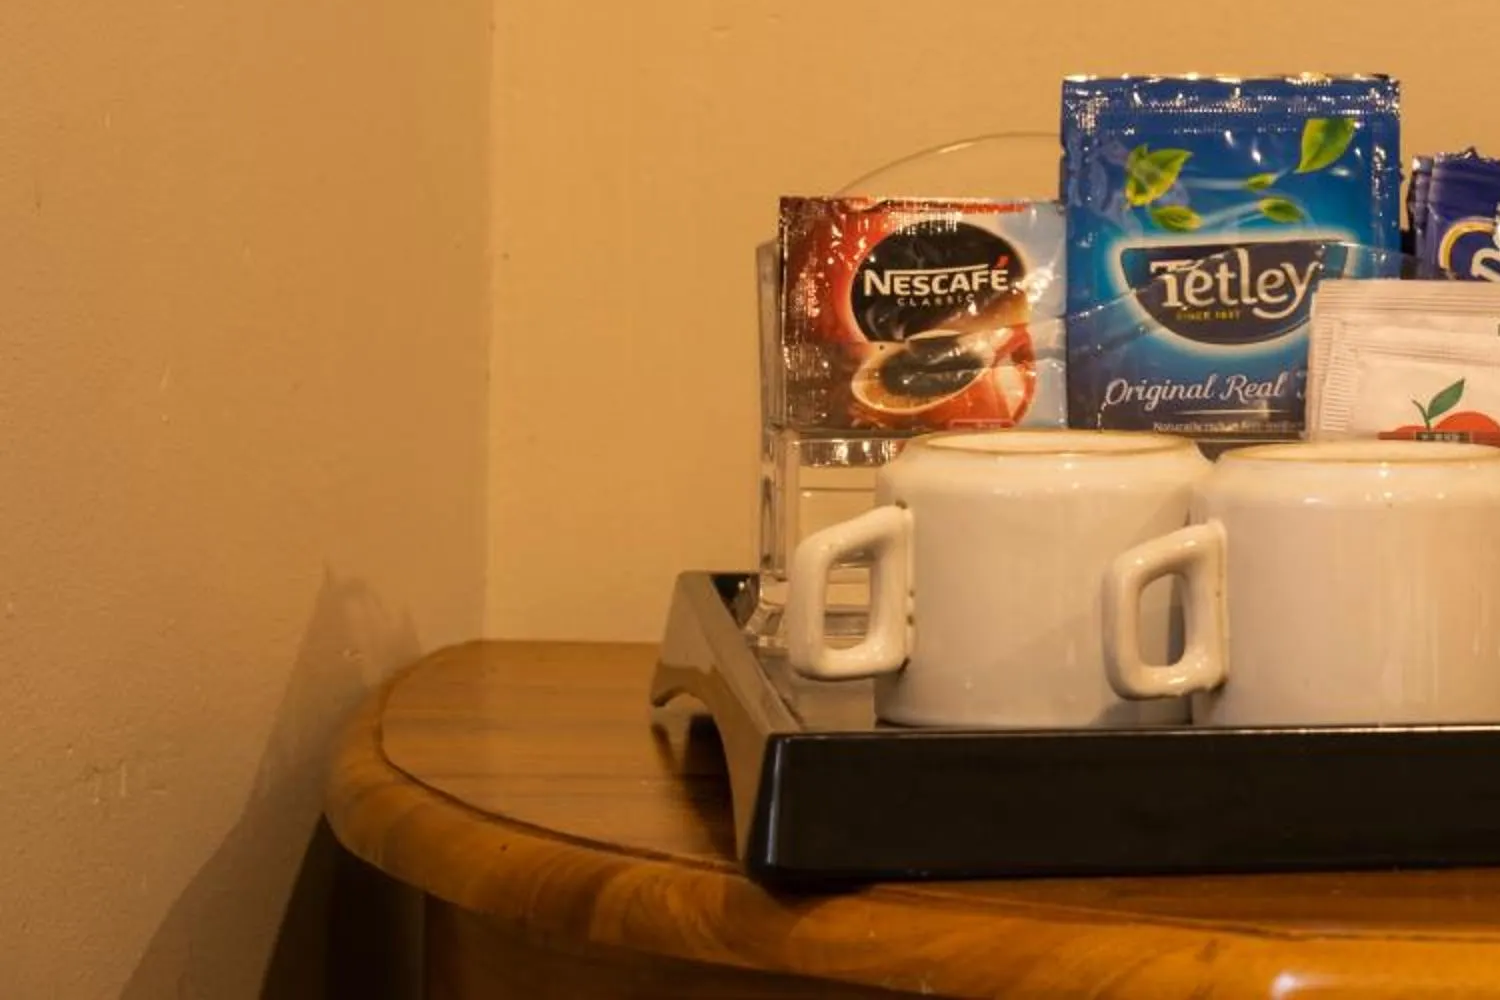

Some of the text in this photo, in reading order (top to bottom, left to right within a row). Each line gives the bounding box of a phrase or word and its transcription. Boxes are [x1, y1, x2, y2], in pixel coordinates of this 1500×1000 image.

[863, 255, 1009, 296] NESCAFÉ
[1150, 247, 1322, 319] Tetley
[1105, 372, 1219, 411] Original
[1220, 370, 1289, 404] Real
